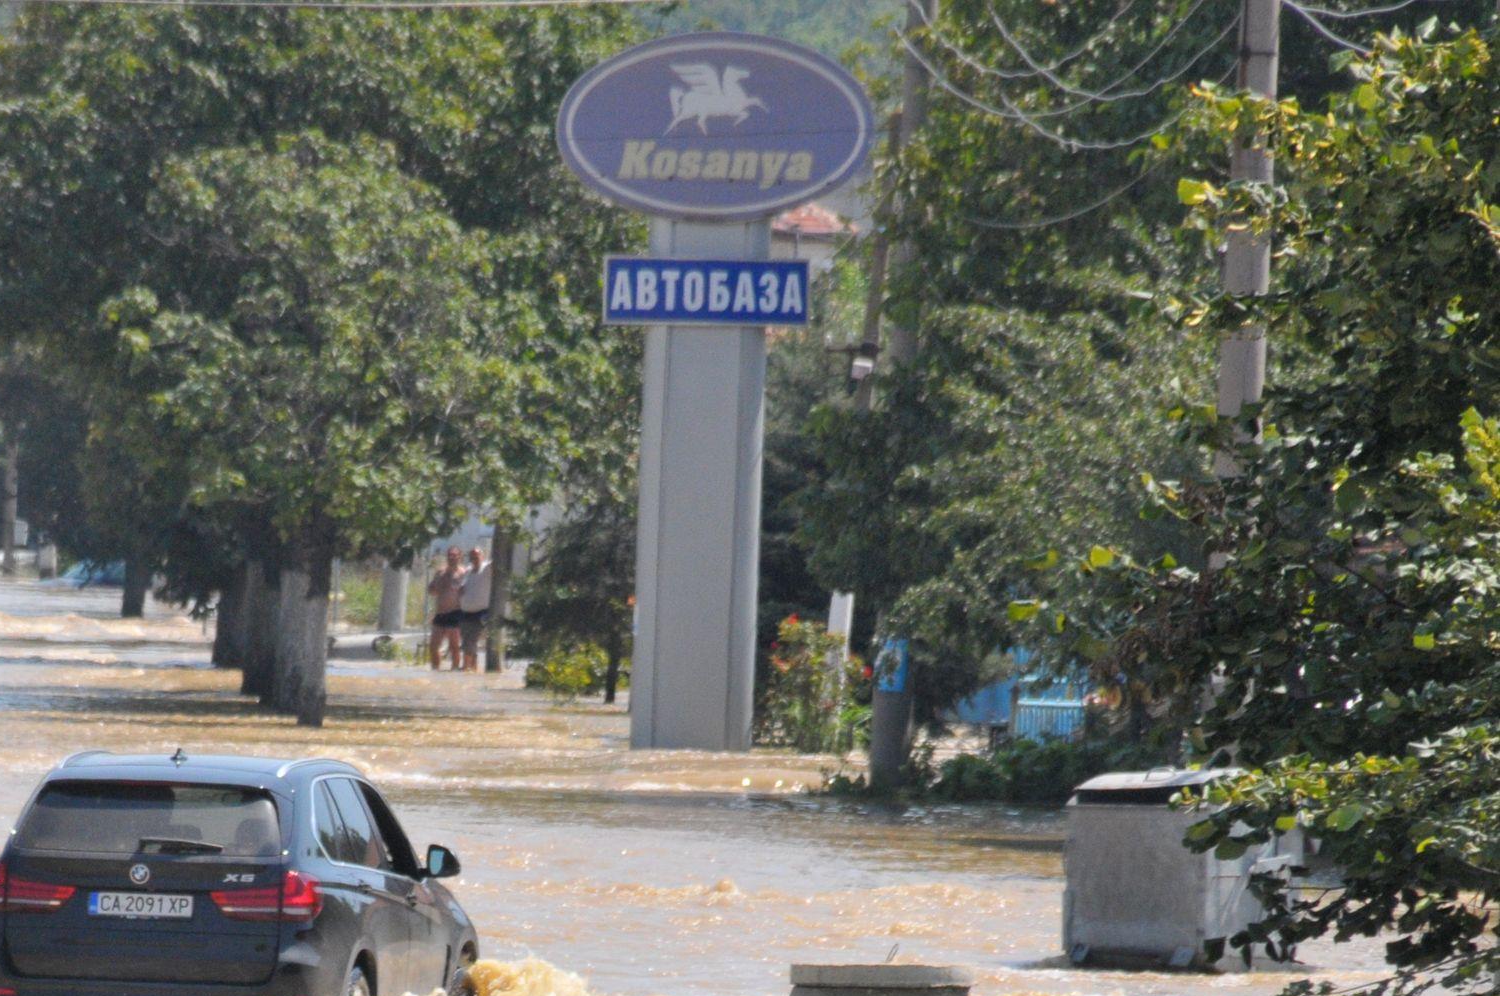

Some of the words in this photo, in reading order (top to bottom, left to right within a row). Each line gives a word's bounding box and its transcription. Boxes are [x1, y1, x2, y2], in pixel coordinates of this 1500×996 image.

[617, 138, 814, 190] Kosanya
[610, 268, 803, 315] АВТОБАЗА
[125, 896, 164, 913] 2091
